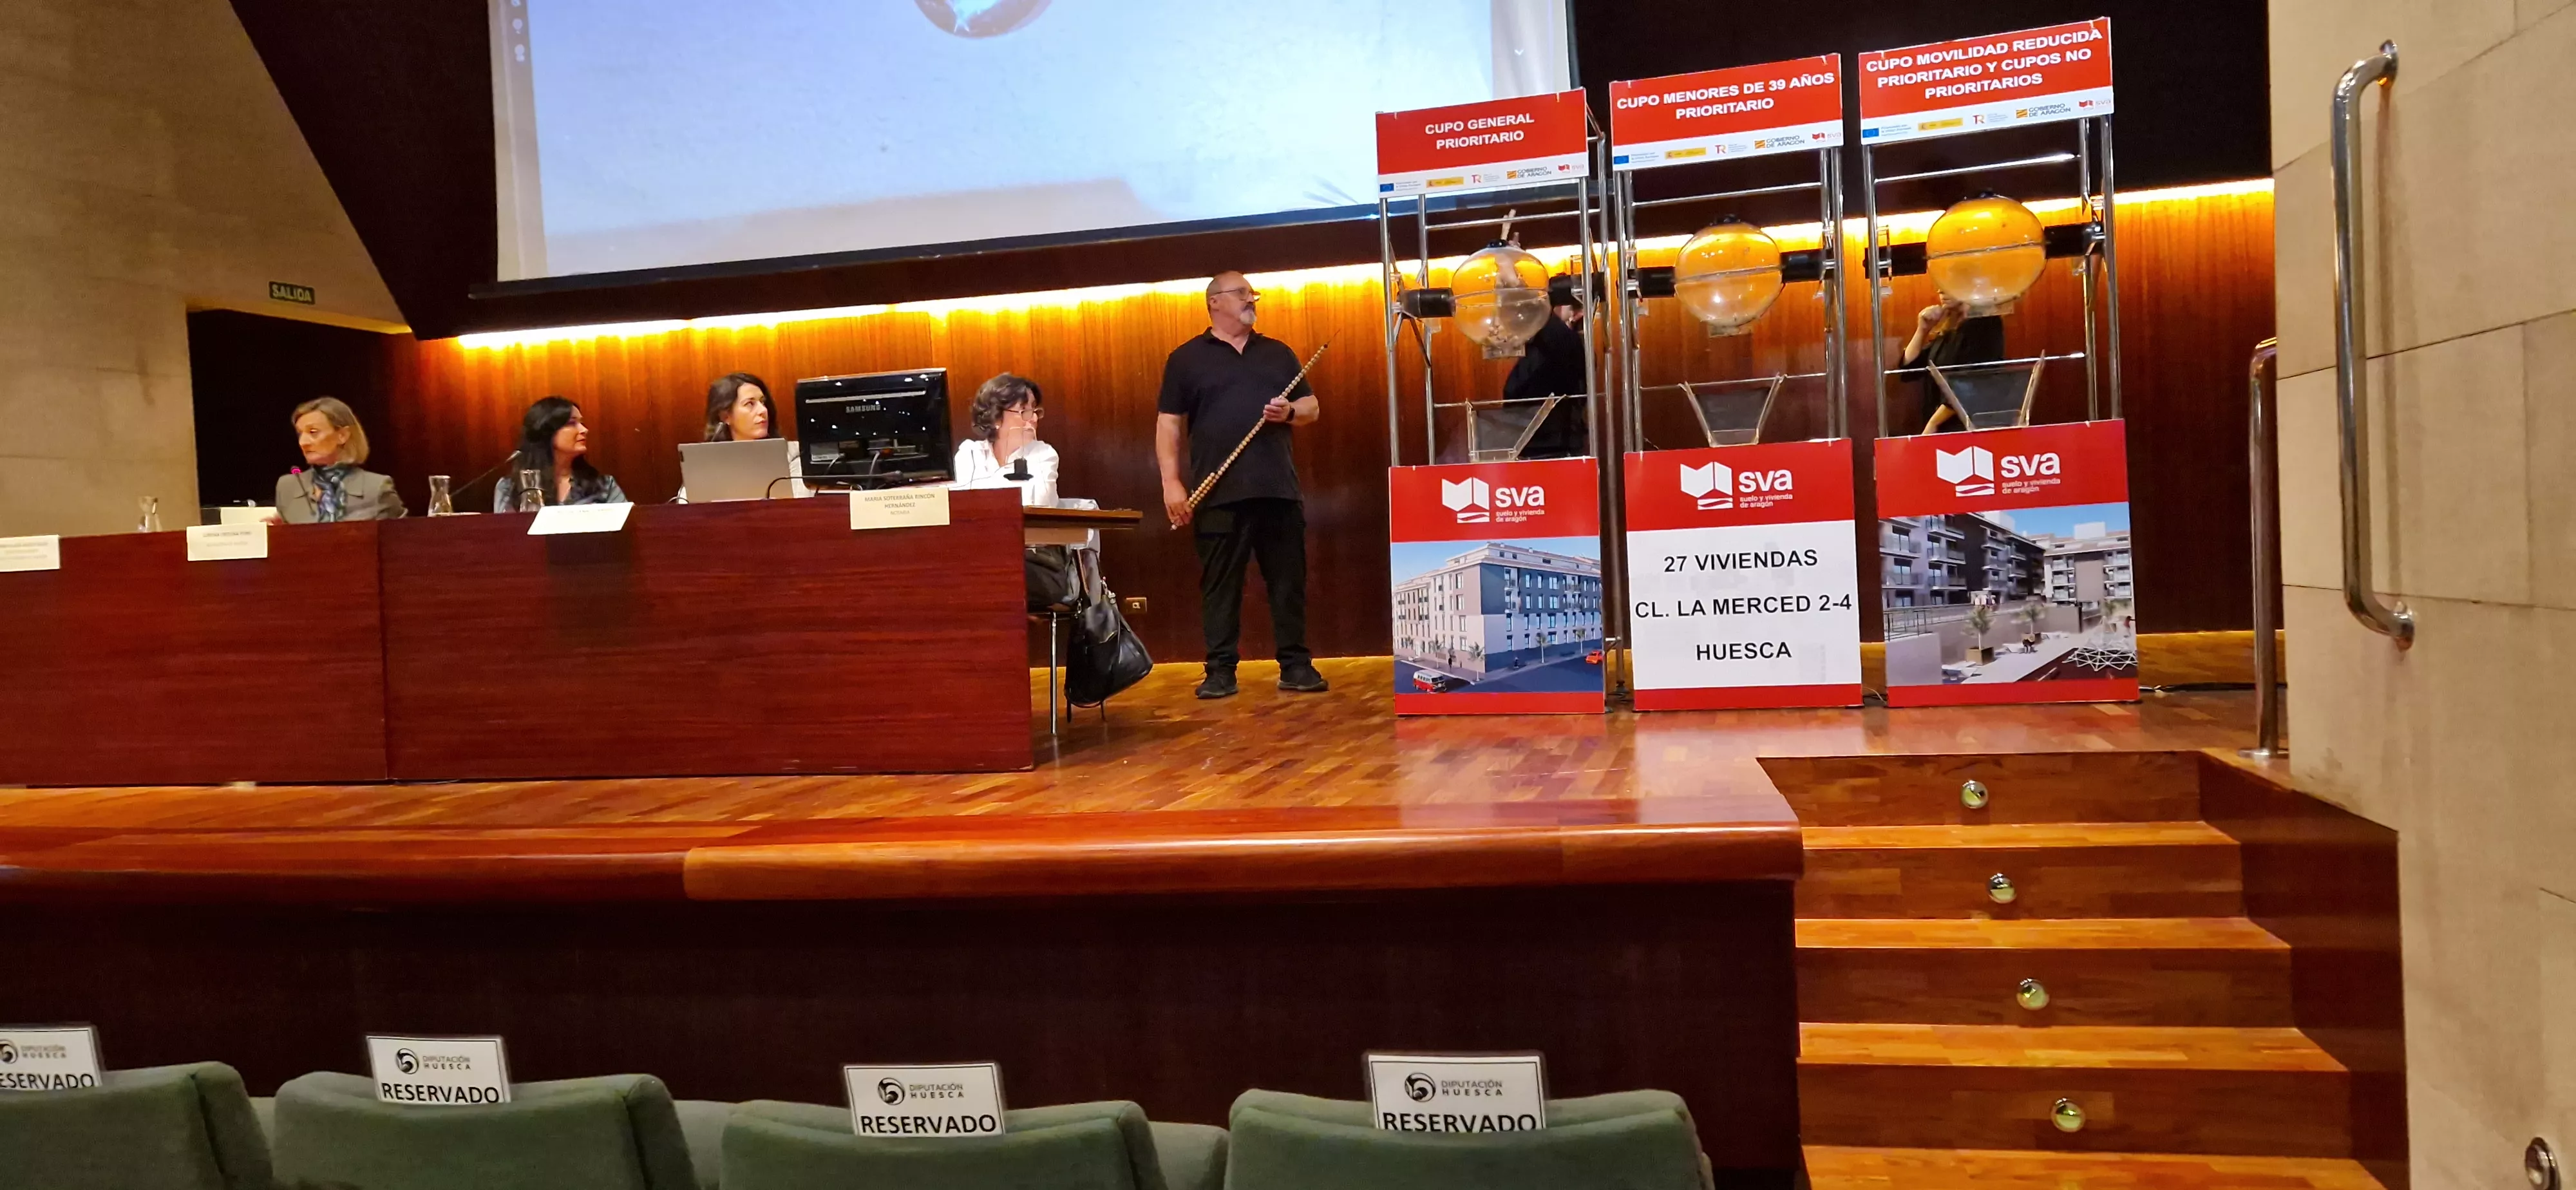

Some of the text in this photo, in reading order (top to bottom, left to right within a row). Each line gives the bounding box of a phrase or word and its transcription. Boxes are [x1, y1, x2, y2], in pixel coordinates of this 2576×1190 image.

[1867, 28, 2103, 72] CUPO MOVILIDAD REDUCIDA
[1877, 48, 2092, 88] PRIORITARIO Y CUPOS NO
[1617, 72, 1835, 109] CUPO MENORES DE 39 AÑOS
[1925, 73, 2043, 99] PRIORITARIOS
[1676, 98, 1774, 119] PRIORITARIO
[2029, 103, 2065, 113] GOBIERNO
[1425, 113, 1535, 135] CUPO GENERAL
[1436, 130, 1524, 150] PRIORITARIO
[1766, 135, 1800, 144] GOBIERNO
[272, 284, 312, 301] SALIDA
[846, 404, 881, 413] SAMSUNG
[2000, 453, 2060, 478] sva
[1739, 469, 1793, 493] sva
[1495, 486, 1544, 507] sva
[1664, 549, 1818, 572] 27 VIVIENDAS
[1635, 594, 1852, 618] CL. LA MERCED 2-4
[1696, 641, 1792, 661] HUESCA
[422, 1055, 470, 1063] DIPUTACIÓN
[0, 1073, 94, 1089] ESERVADO
[909, 1082, 963, 1091] DIPUTACIÓN
[1441, 1079, 1502, 1088] DIPUTACIÓN
[381, 1082, 499, 1104] RESERVADO
[860, 1114, 996, 1134] RESERVADO
[1383, 1111, 1537, 1133] RESERVADO
